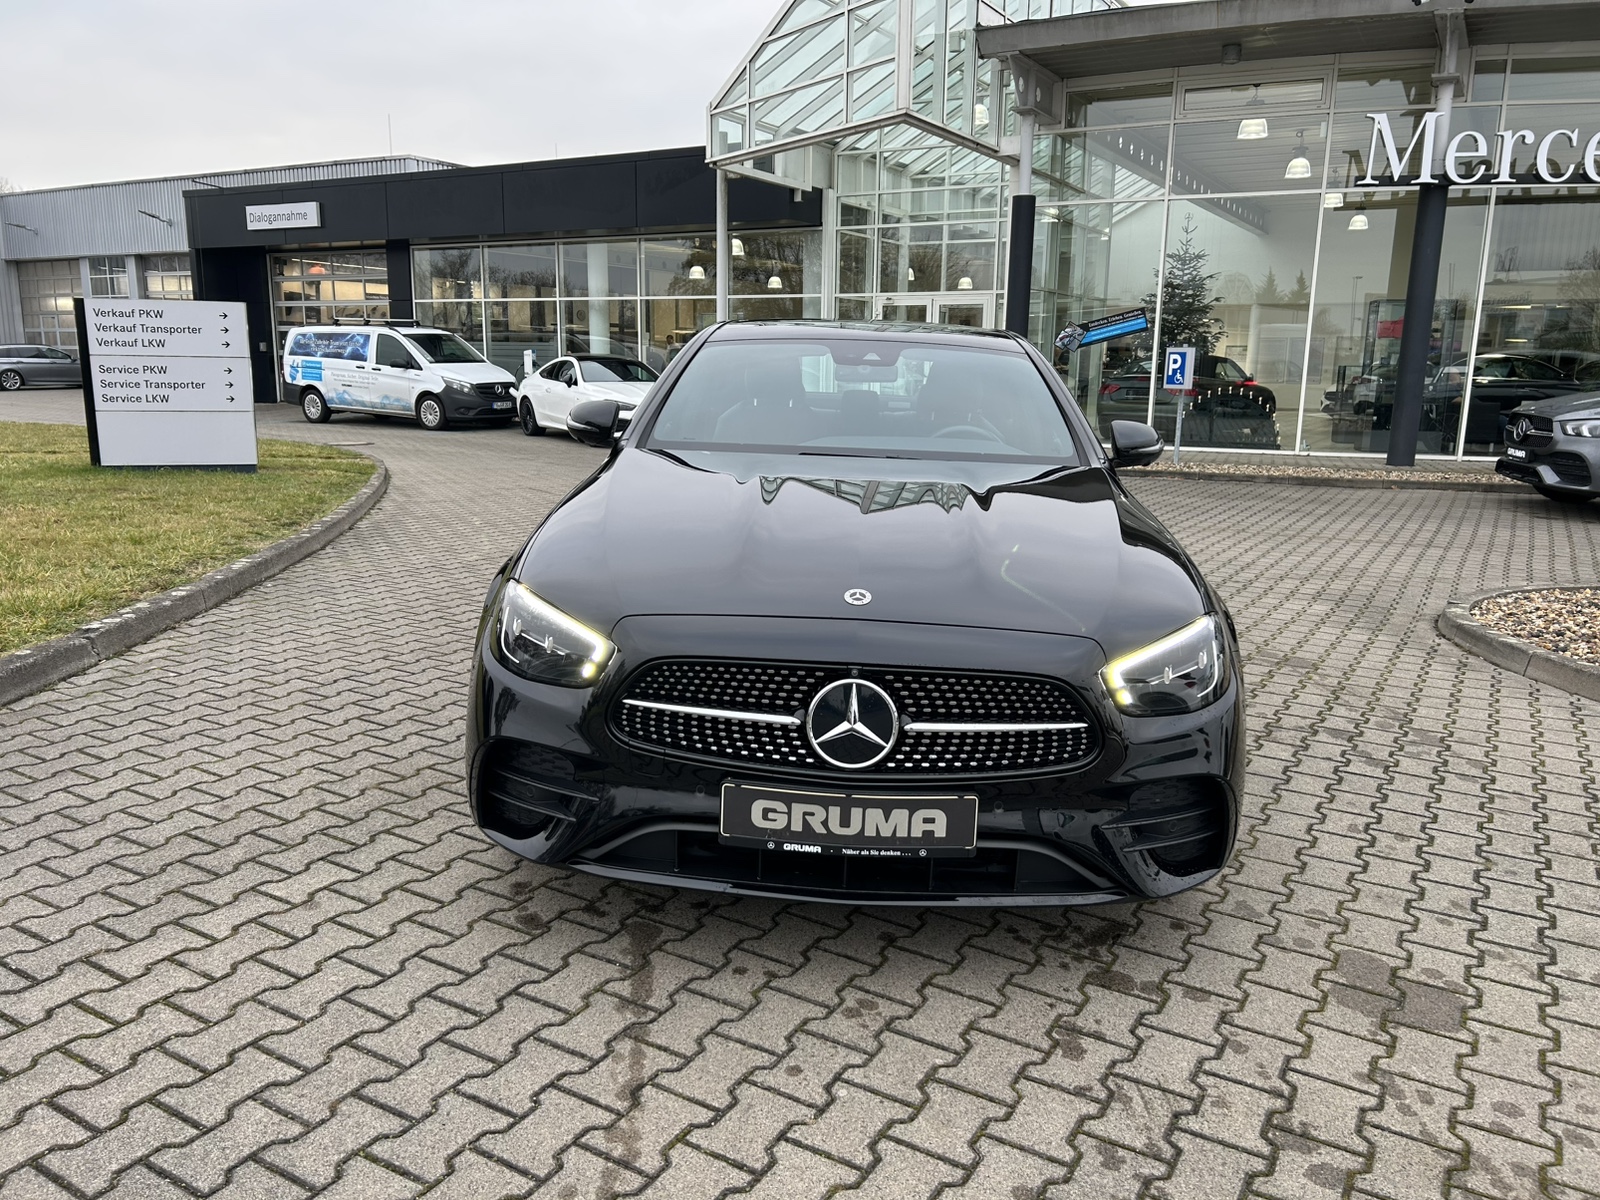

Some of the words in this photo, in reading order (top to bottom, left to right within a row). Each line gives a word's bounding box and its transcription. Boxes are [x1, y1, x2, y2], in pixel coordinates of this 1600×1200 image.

[249, 210, 308, 225] Dialogannahme
[92, 307, 135, 318] Verkauf
[138, 309, 164, 319] PKW
[94, 323, 137, 333] Verkauf
[140, 323, 203, 335] Transporter
[95, 337, 138, 347] Verkauf
[141, 338, 166, 348] LKW
[98, 364, 139, 374] Service
[142, 365, 168, 375] PKW
[1168, 354, 1181, 375] P
[99, 379, 141, 389] Service
[143, 380, 206, 391] Transporter
[101, 393, 142, 403] Service
[145, 394, 170, 403] LKW
[751, 799, 947, 837] GRUMA
[783, 843, 822, 853] GRUMA
[842, 848, 860, 856] Näher
